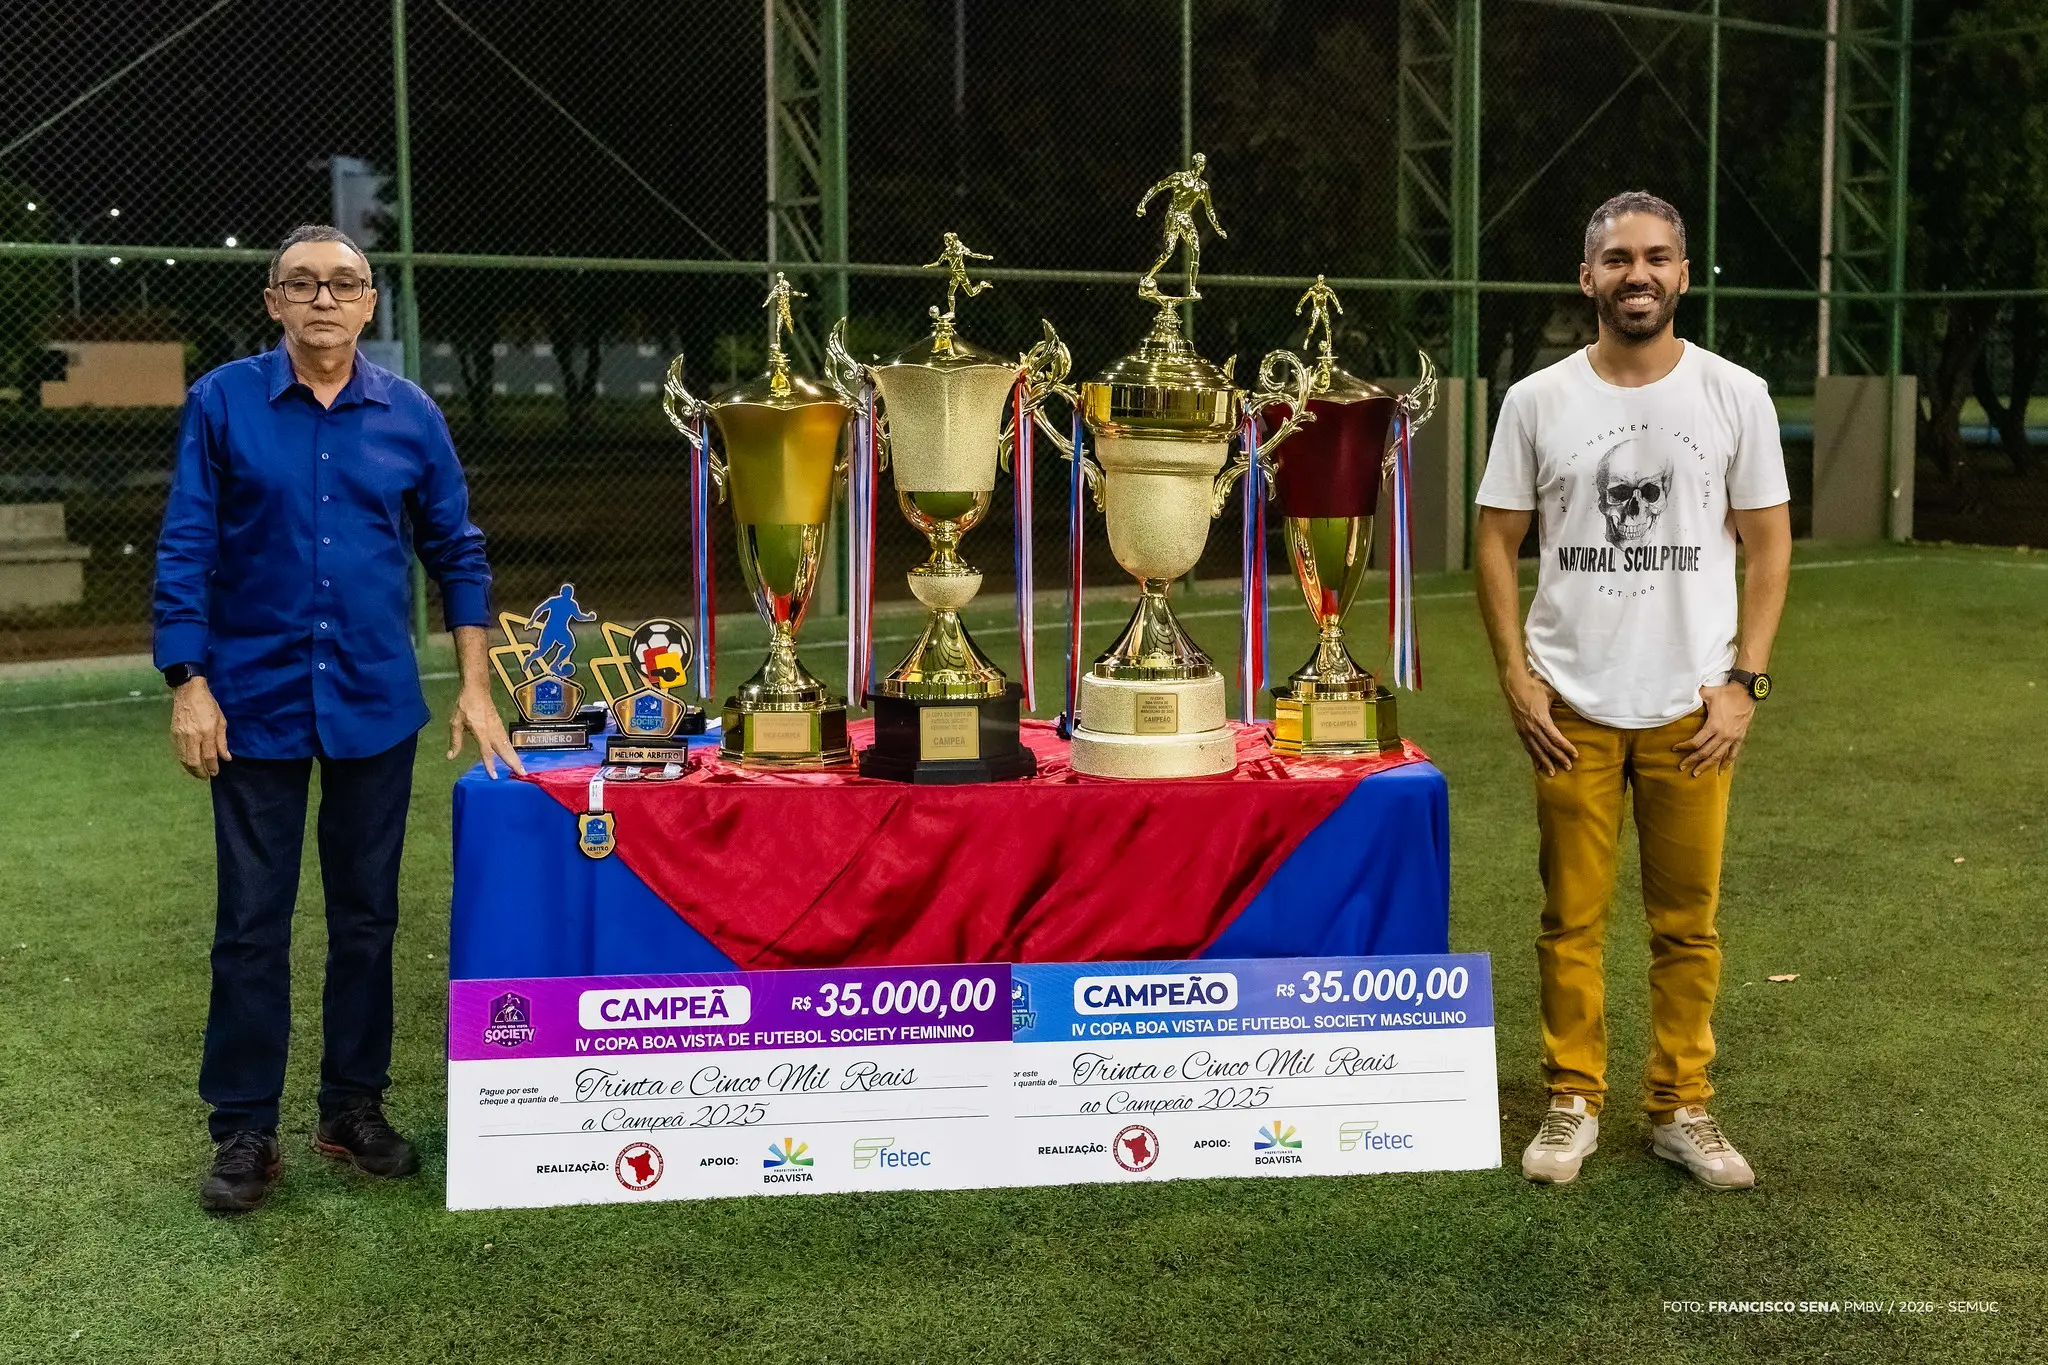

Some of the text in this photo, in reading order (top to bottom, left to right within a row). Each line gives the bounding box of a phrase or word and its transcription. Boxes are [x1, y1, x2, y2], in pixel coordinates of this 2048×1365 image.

[1566, 453, 1578, 466] IN
[1587, 424, 1648, 447] HEAVEN
[1674, 431, 1706, 461] JOHN
[1702, 471, 1710, 509] JOHN
[1558, 545, 1701, 572] NATURAL SCULPTURE
[630, 717, 665, 728] SOCIETY
[791, 977, 996, 1019] R$ 35.000,00
[1083, 976, 1229, 1009] CAMPEÃO
[1276, 966, 1469, 1006] R$ 35.000,00
[600, 988, 730, 1022] CAMPEÃ
[485, 1028, 535, 1043] SOCIETY
[1072, 1011, 1466, 1036] IV COPA BOA VISTA DE FUTEBOL SOCIETY MASCULINO
[575, 1024, 974, 1051] IV COPA BOA VISTA DE FUTEBOL SOCIETY FEMININO
[1073, 1046, 1399, 1086] Trinta e Cinco Mil Reais
[480, 1086, 539, 1097] Pague por este
[575, 1061, 919, 1103] Trinta e Cinco Mil Reais
[1018, 1078, 1057, 1088] quantia de
[480, 1097, 509, 1106] cheque
[517, 1096, 547, 1105] quantia
[548, 1095, 559, 1103] de
[1080, 1085, 1274, 1116] ao Campeão 2025
[581, 1100, 770, 1133] a Campeã 2025
[1038, 1143, 1107, 1155] REALIZAÇÃO:
[1193, 1139, 1231, 1149] APOIO:
[1364, 1130, 1414, 1150] fetec
[536, 1160, 609, 1174] REALIZAÇÃO:
[700, 1156, 739, 1167] APOIO:
[879, 1147, 931, 1168] fetec
